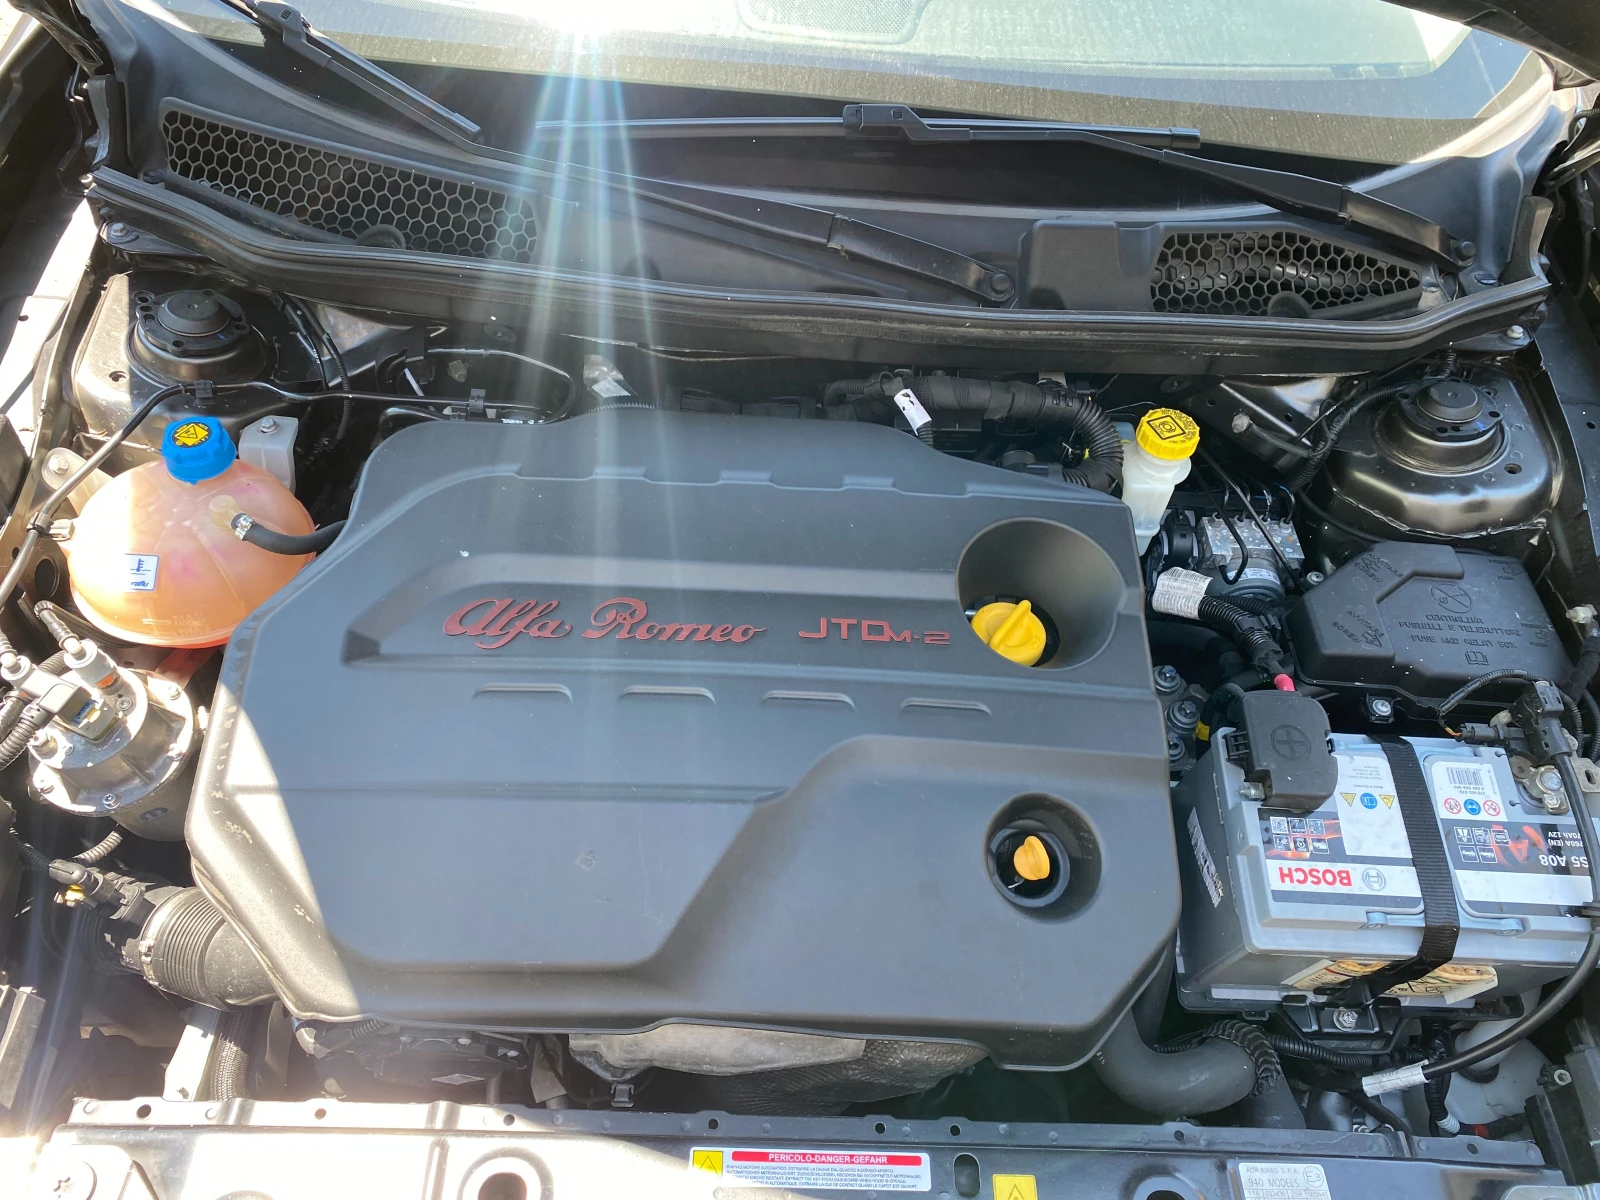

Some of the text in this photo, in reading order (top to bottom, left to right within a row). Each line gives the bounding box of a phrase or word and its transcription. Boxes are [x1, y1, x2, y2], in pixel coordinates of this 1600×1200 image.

[443, 597, 767, 650] Alfa Romeo
[1411, 634, 1437, 644] FUSE
[1464, 638, 1494, 648] RELAY
[1498, 641, 1518, 649] BOX
[1548, 838, 1564, 846] (EN)
[1538, 854, 1589, 868] S5 A08
[1278, 866, 1352, 886] BOSCH
[768, 1153, 888, 1165] PERICOLO-DANGER-GEFAHR
[1248, 1178, 1300, 1188] 940 MODELS
